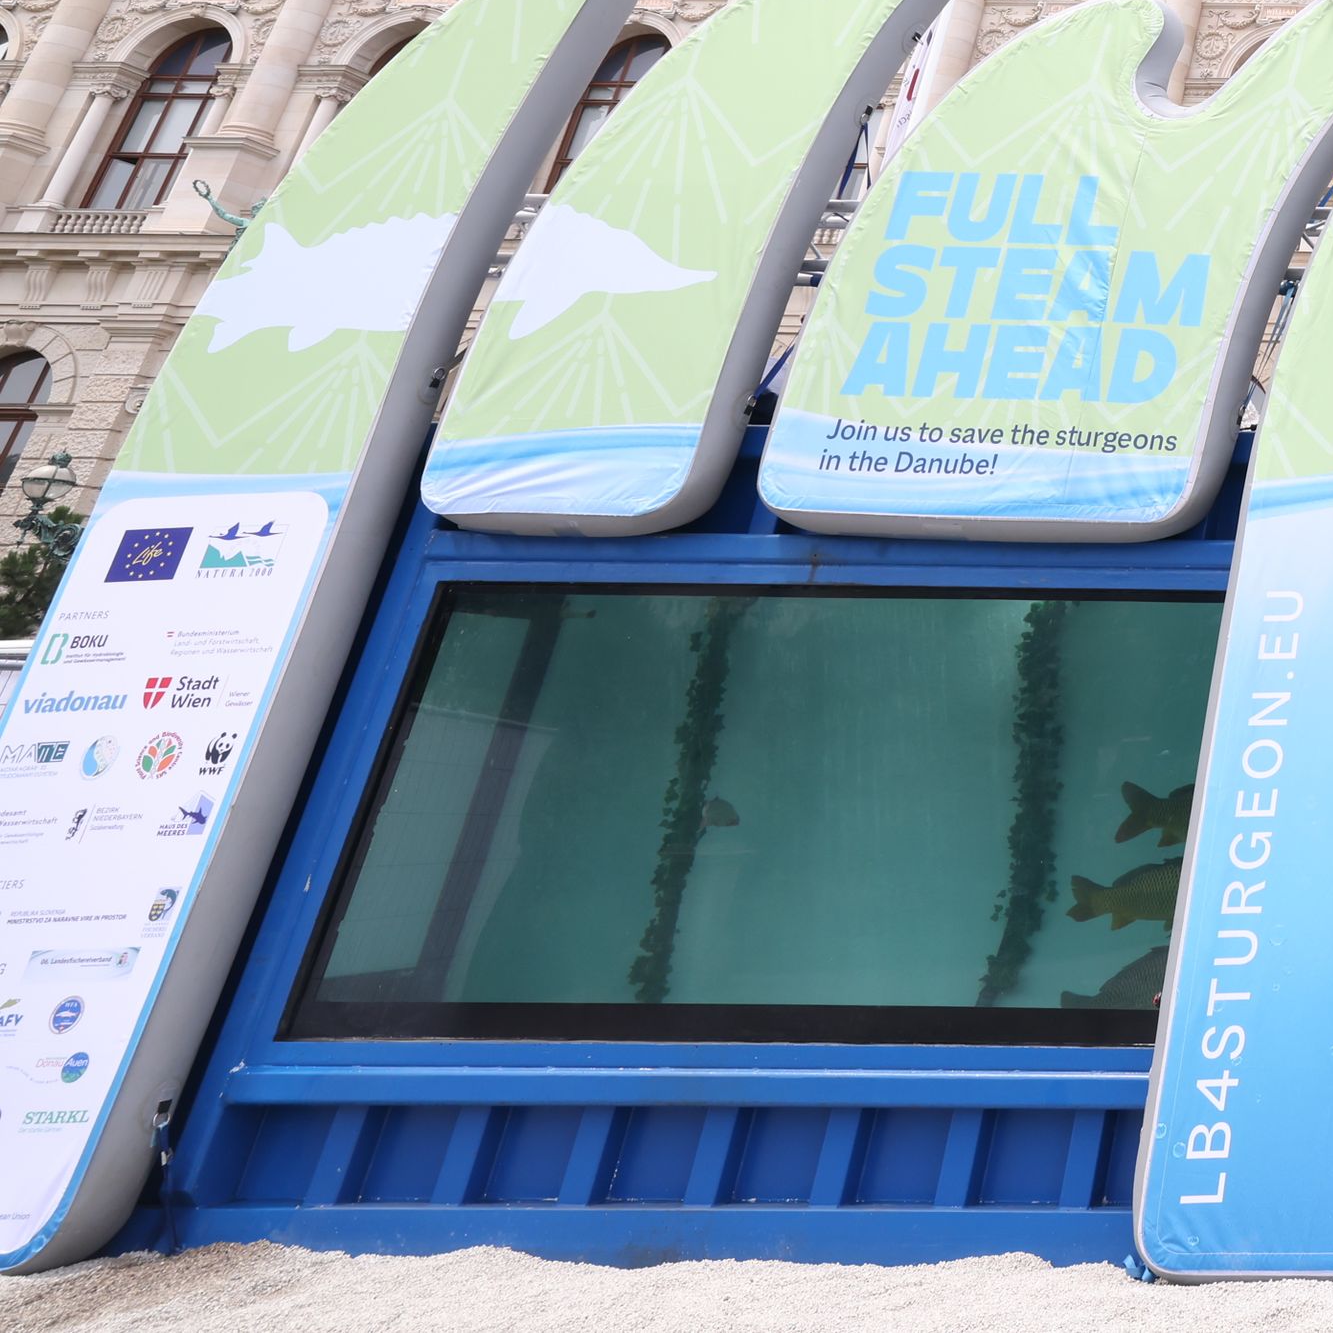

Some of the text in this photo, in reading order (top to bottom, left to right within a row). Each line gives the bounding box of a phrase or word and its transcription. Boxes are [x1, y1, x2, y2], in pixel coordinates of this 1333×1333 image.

[883, 170, 1120, 247] FULL
[864, 244, 1212, 327] STEAM
[840, 321, 1177, 404] AHEAD
[826, 418, 1178, 454] Join us to save the sturgeons
[819, 448, 999, 475] in the Danube!
[132, 541, 163, 566] Life
[195, 566, 274, 580] NATURA 2000
[59, 610, 110, 621] PARTNERS
[70, 634, 109, 649] BOKU
[176, 675, 220, 691] Stadt
[23, 690, 129, 714] viadonau
[171, 693, 212, 708] Wien
[199, 767, 224, 776] WWF
[93, 814, 144, 822] NIEDERBAYERN
[157, 829, 186, 837] MEERES
[1179, 589, 1304, 1206] LB4STURGEON.EU
[66, 1057, 88, 1067] Auen
[22, 1109, 90, 1125] STARKL
